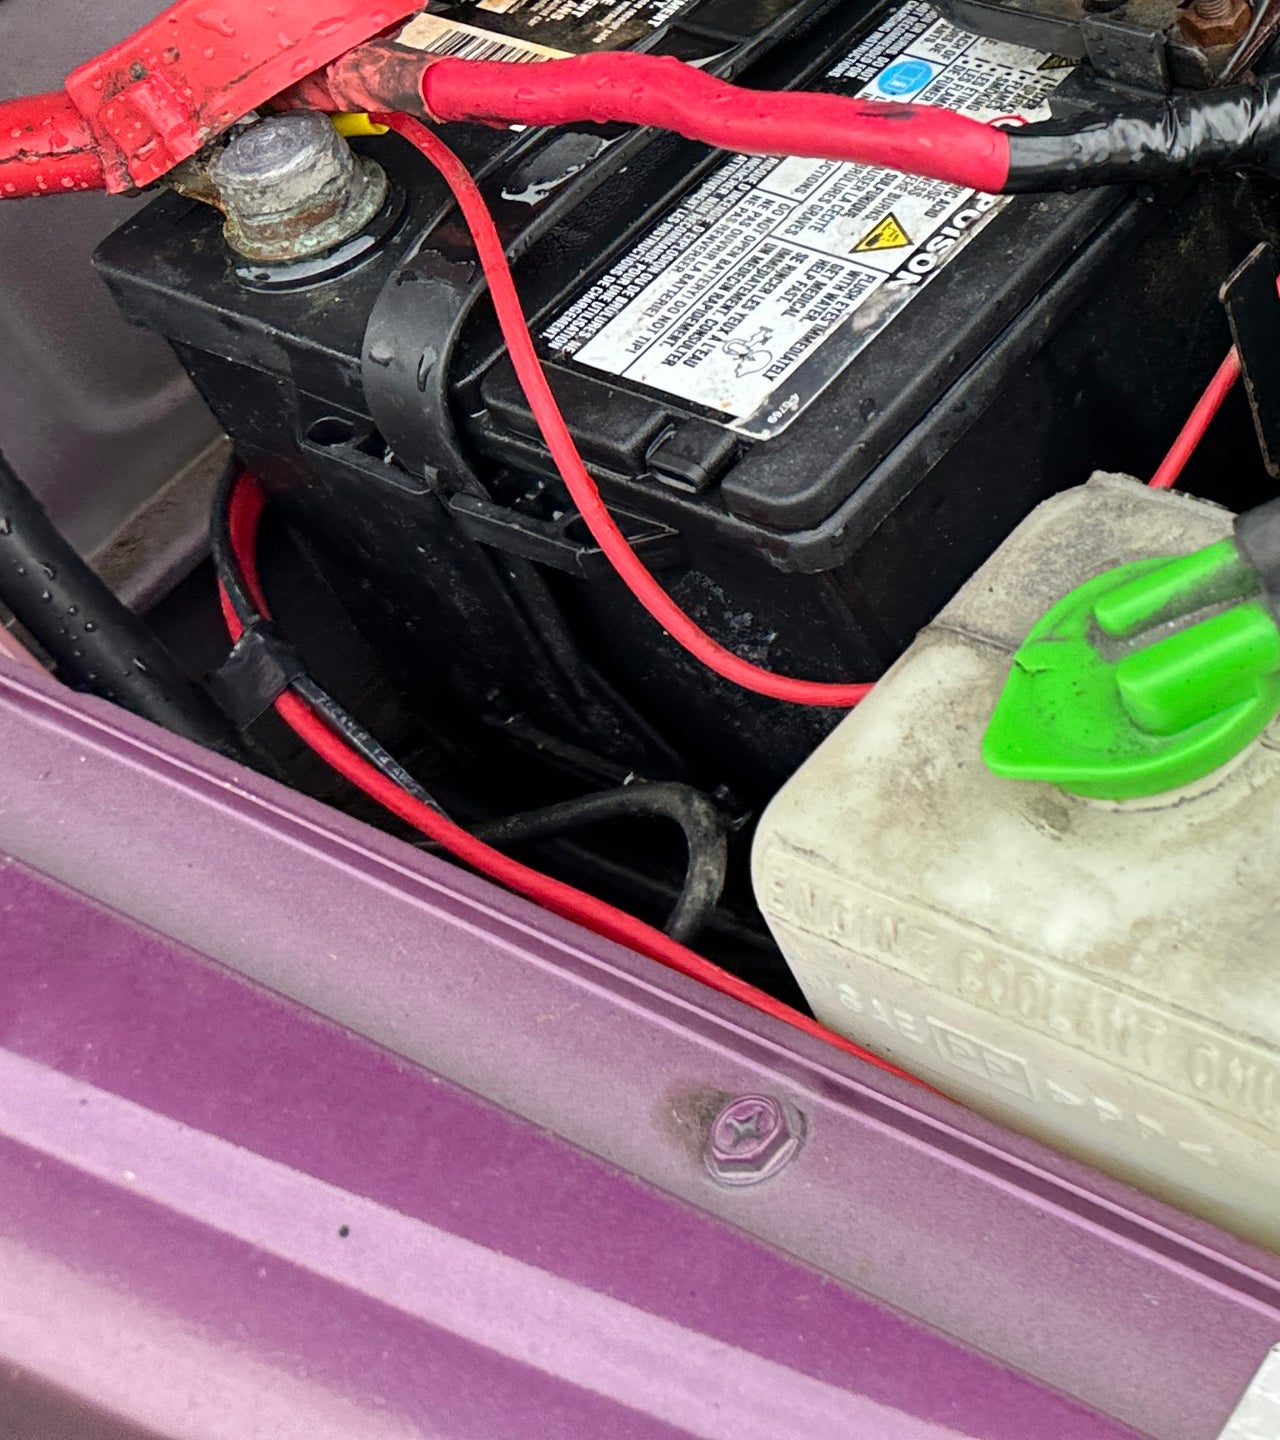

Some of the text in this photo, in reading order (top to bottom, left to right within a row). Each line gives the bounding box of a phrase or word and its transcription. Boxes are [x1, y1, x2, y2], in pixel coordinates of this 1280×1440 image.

[544, 0, 582, 22] ANS.
[876, 0, 919, 33] CHARGING
[911, 1, 932, 16] NOT
[858, 14, 918, 64] RECOMMENDED
[908, 21, 927, 33] OR
[928, 42, 946, 54] DE
[939, 32, 974, 60] ACH OF
[842, 62, 865, 78] FOR
[855, 65, 878, 81] NOT
[870, 55, 889, 68] DO
[918, 64, 965, 103] DE FUMER
[931, 67, 980, 108] LES FLAM
[970, 71, 994, 87] LES
[964, 75, 1009, 112] SMOKING
[984, 79, 1023, 111] FLAMES
[999, 83, 1037, 115] SPARKS
[743, 156, 779, 184] RISQUE
[850, 164, 885, 193] AUSER
[742, 193, 762, 206] NE
[756, 197, 775, 211] NE
[838, 191, 857, 204] LA
[921, 180, 949, 202] AUSE
[693, 195, 719, 214] NON
[724, 206, 748, 224] PAS
[861, 191, 901, 224] BURNS.
[923, 198, 950, 219] ACID
[738, 209, 762, 228] PAS
[780, 203, 825, 239] GRAVES.
[538, 154, 748, 341] ATTENTIVEMENT LES INSTRUCTIONS DE CHARGEMENT.
[702, 227, 743, 261] OUVRIR
[757, 242, 777, 255] UN
[885, 191, 997, 294] POISON
[688, 260, 708, 274] LA
[789, 251, 808, 264] SE
[616, 262, 647, 286] POUR
[623, 202, 791, 355] DO NOT OPEN BATTERY! DO NOT TIP!
[633, 272, 654, 286] OU
[757, 263, 796, 295] RINCER
[775, 258, 830, 305] HELP FAST.
[598, 284, 623, 303] UNE
[621, 284, 641, 298] DE
[740, 293, 764, 311] LES
[779, 262, 844, 319] GET MEDICAL
[798, 268, 862, 325] WITH WATER.
[547, 300, 605, 350] UTILISATION
[658, 291, 725, 350] RAPIDEMENT.
[716, 309, 748, 335] YEUX
[761, 273, 877, 382] FLUSH EYES IMMEDIATELY
[560, 339, 582, 354] NE
[660, 317, 718, 368] CONSULTER
[682, 341, 715, 368] L'EAU
